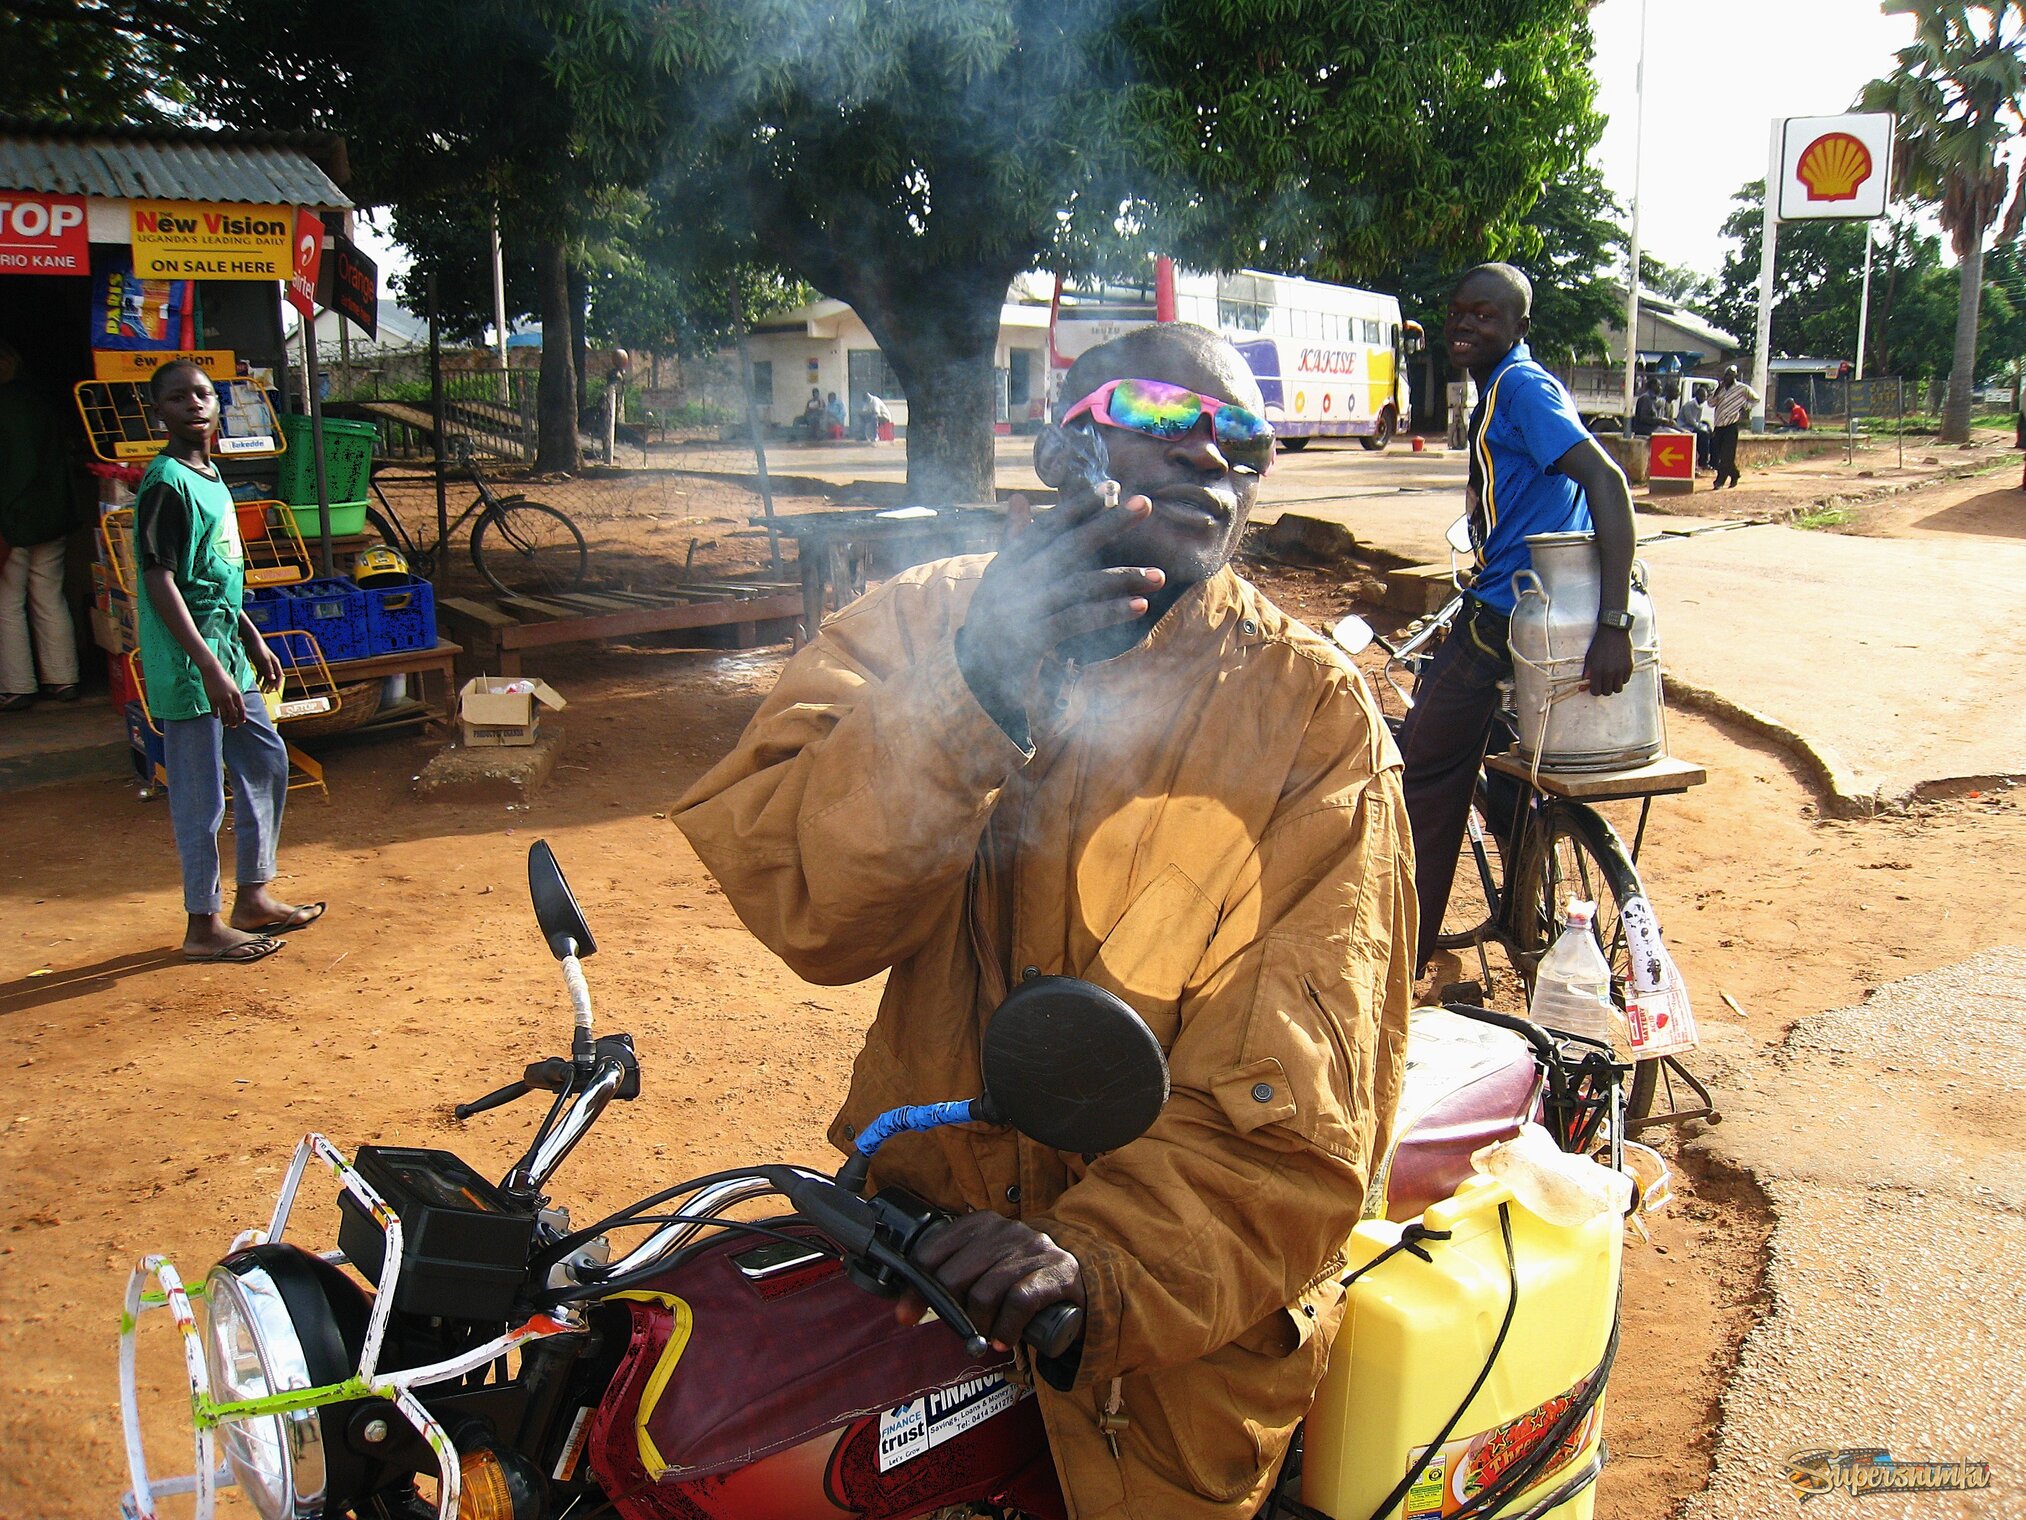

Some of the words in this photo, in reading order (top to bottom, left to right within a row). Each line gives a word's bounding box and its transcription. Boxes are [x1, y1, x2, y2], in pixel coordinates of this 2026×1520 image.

[136, 211, 198, 233] New
[203, 213, 286, 236] Vision
[138, 235, 198, 244] UGANDA'S
[202, 236, 251, 245] LEADING
[256, 238, 286, 246] DAILY
[32, 255, 77, 268] KANE
[151, 260, 179, 272] ON
[183, 260, 227, 273] SALE
[232, 261, 276, 273] HERE
[291, 269, 315, 303] airtel
[338, 252, 375, 305] Orange
[1639, 1007, 1650, 1041] BATTERY
[1648, 1015, 1657, 1033] ACID
[961, 1404, 981, 1418] Loans
[988, 1389, 1009, 1403] Money
[882, 1410, 922, 1438] FINANCE
[956, 1419, 970, 1431] Tel:
[972, 1409, 989, 1423] 0414
[881, 1420, 925, 1455] trust
[888, 1455, 903, 1466] Let's
[905, 1446, 921, 1458] Grow
